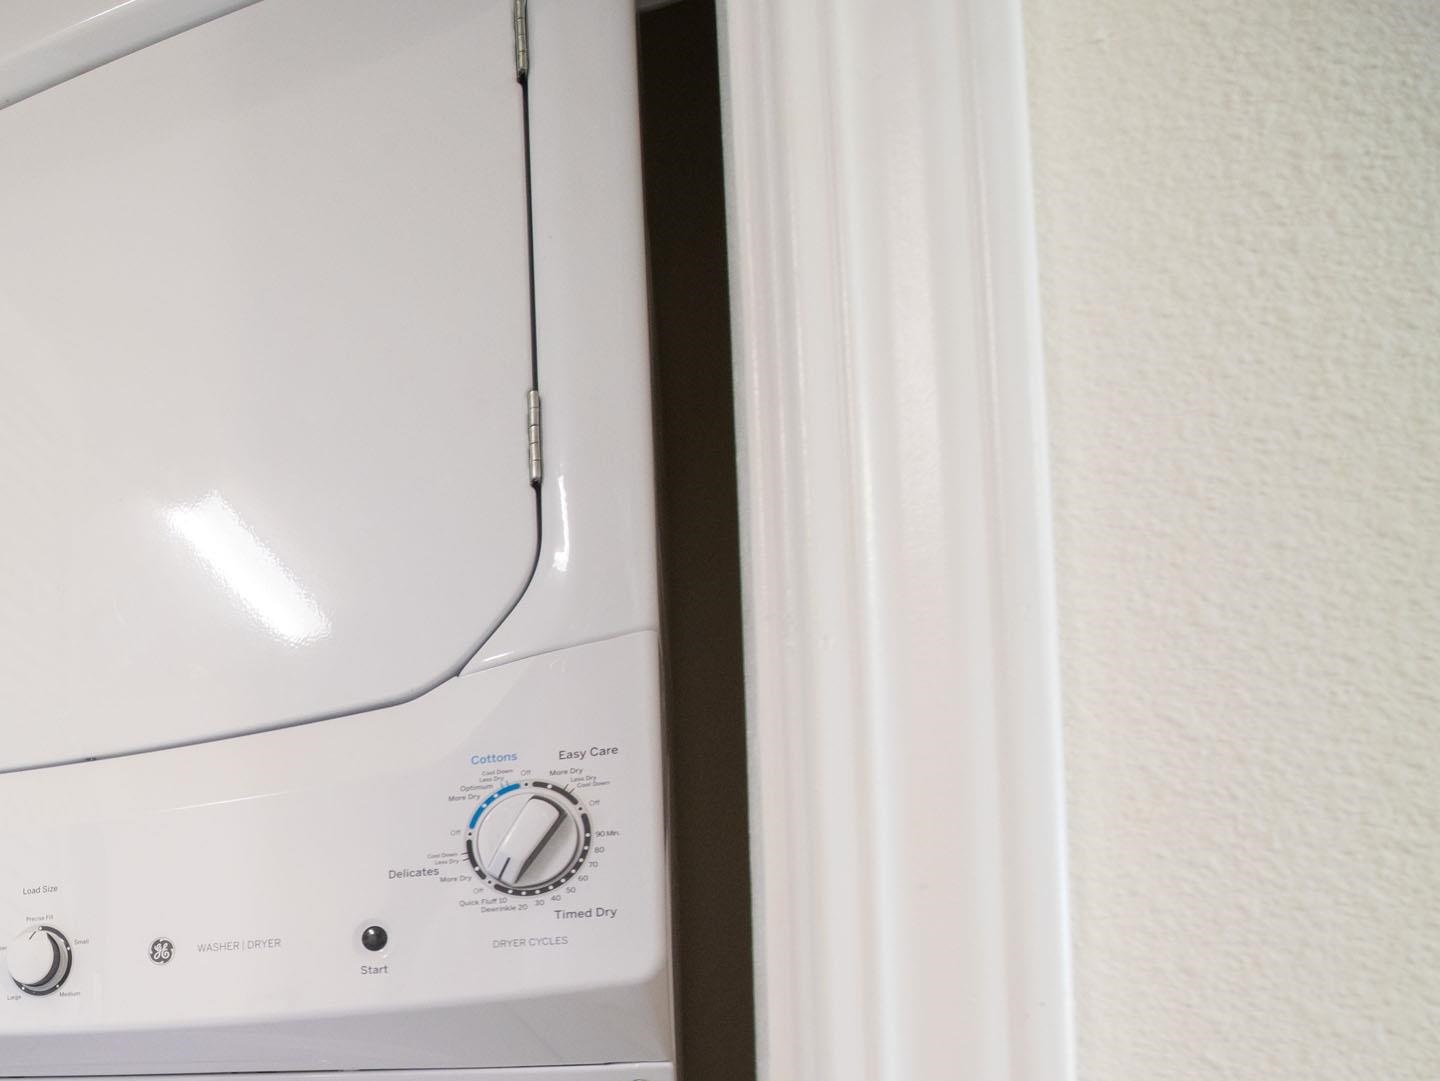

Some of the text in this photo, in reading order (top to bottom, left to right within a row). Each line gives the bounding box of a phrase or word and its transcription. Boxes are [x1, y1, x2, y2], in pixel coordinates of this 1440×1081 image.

[471, 753, 519, 765] Cottons
[559, 747, 618, 760] Easy Care
[388, 868, 440, 880] Delicates
[22, 885, 58, 895] Load Size
[554, 907, 618, 920] Timed Dry
[197, 938, 281, 953] WASHER DRYER
[492, 936, 568, 949] DRYER CYCLES
[360, 965, 389, 975] Start
